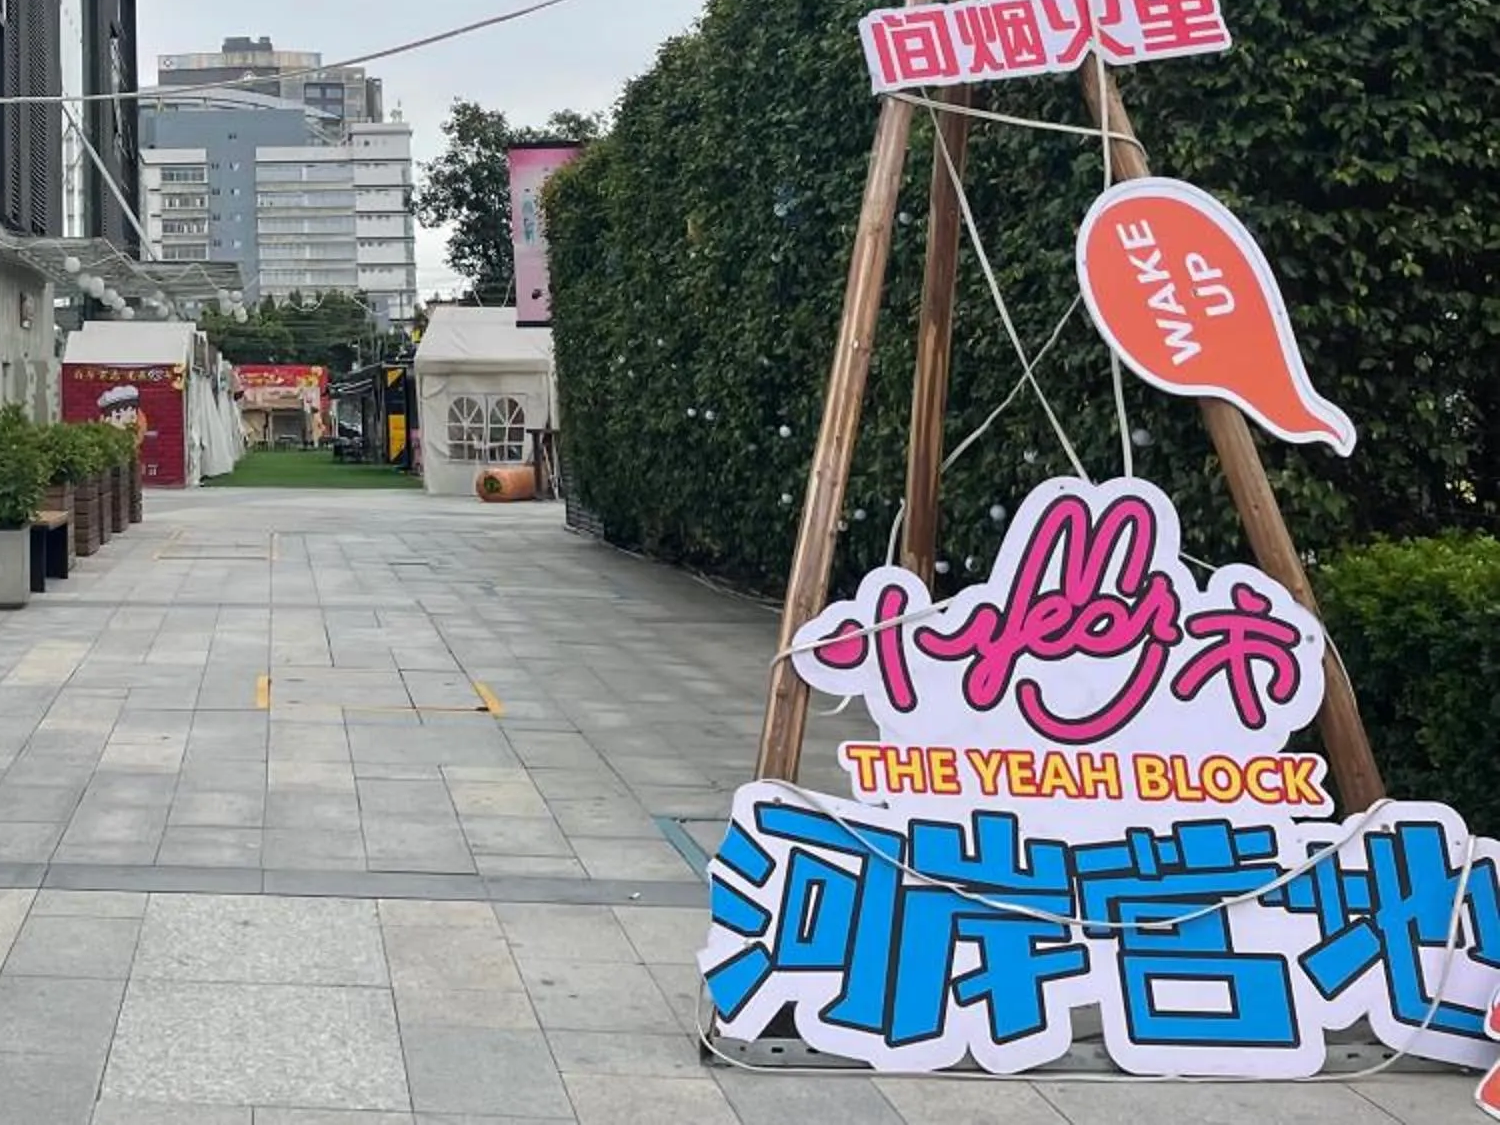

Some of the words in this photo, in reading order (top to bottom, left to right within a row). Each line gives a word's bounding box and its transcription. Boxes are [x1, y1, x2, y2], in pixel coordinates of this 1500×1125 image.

[1117, 218, 1202, 365] WAKE
[1184, 252, 1235, 316] UP
[847, 746, 959, 793] THE
[965, 748, 1123, 801] YEAH
[1138, 754, 1325, 806] BLOCK
